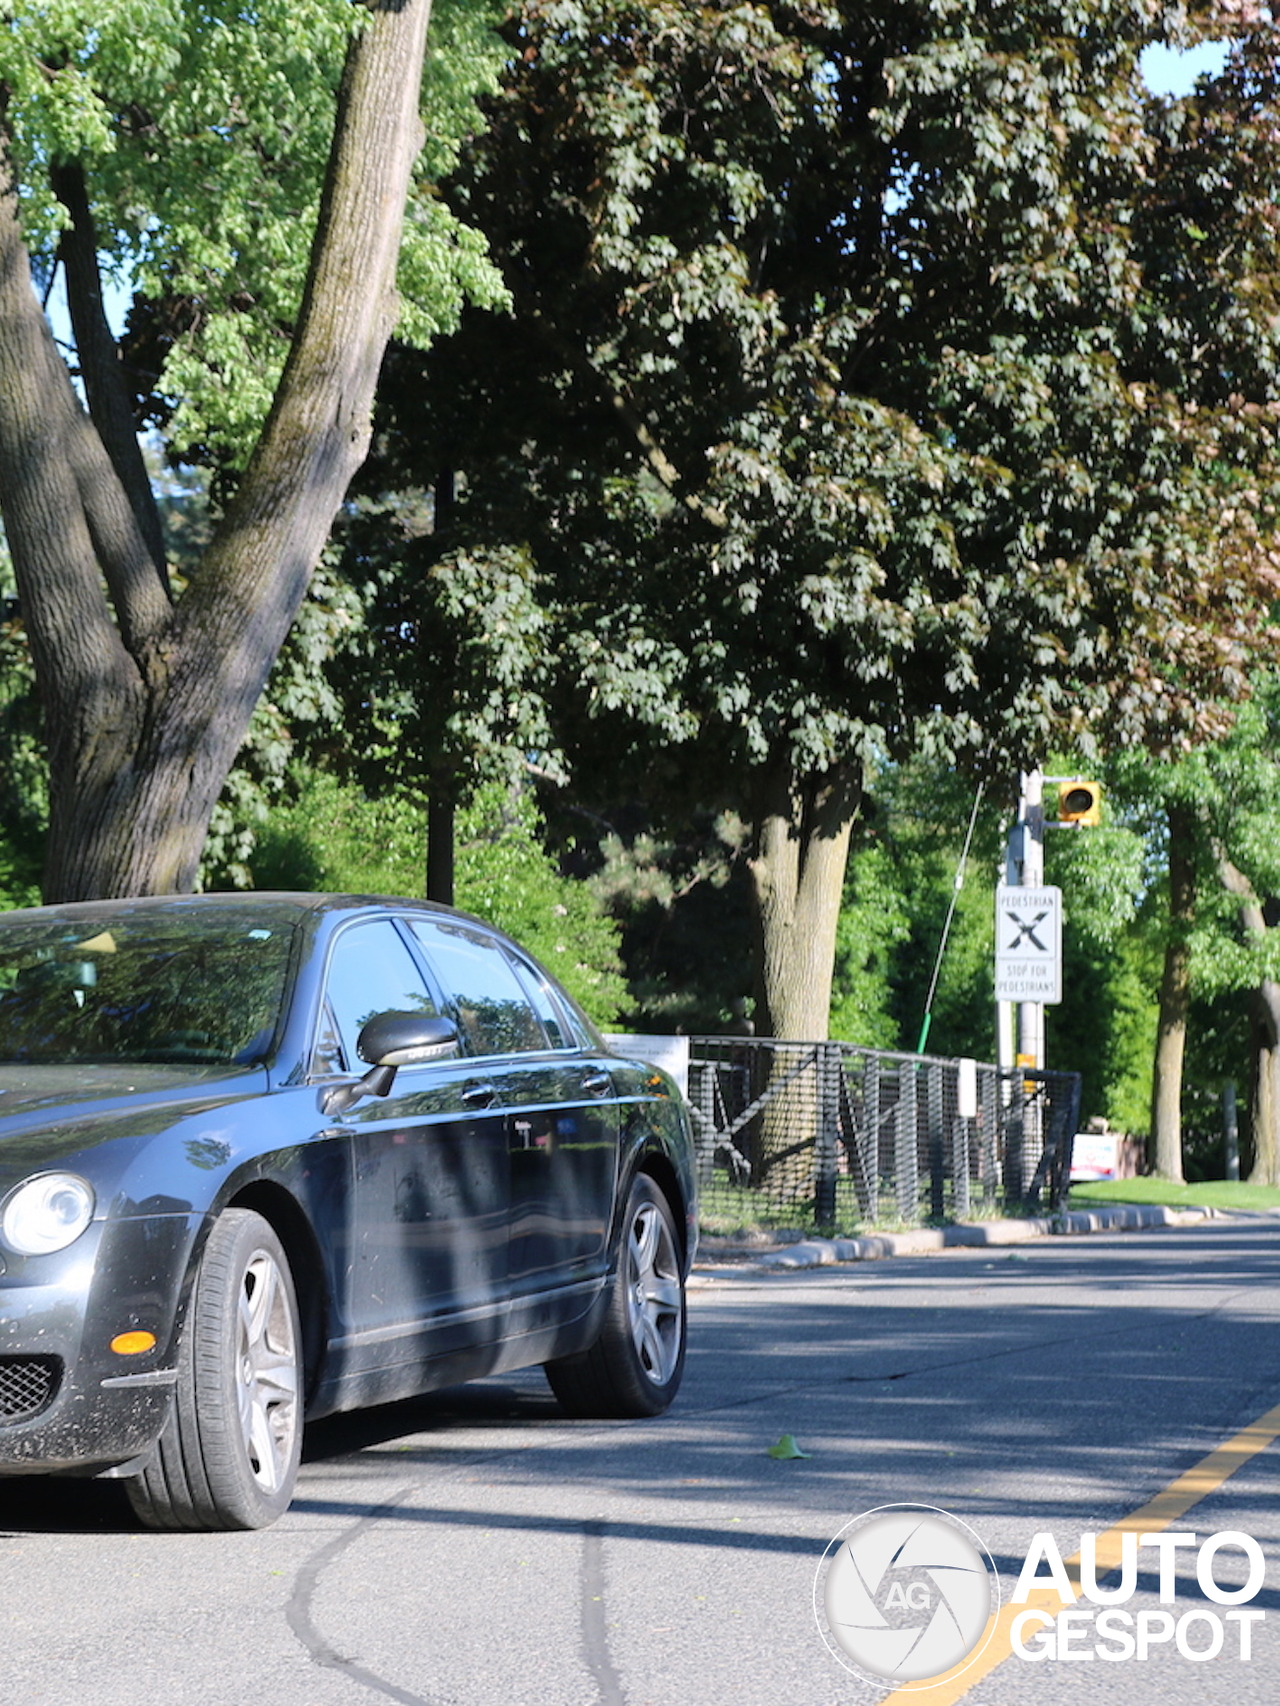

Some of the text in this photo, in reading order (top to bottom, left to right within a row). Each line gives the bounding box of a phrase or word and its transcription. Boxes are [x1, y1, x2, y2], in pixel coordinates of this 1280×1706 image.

[1001, 895, 1054, 907] PEDESTRIAN
[1007, 965, 1047, 977] STOP FOR
[999, 981, 1055, 993] PEDESTRIANS
